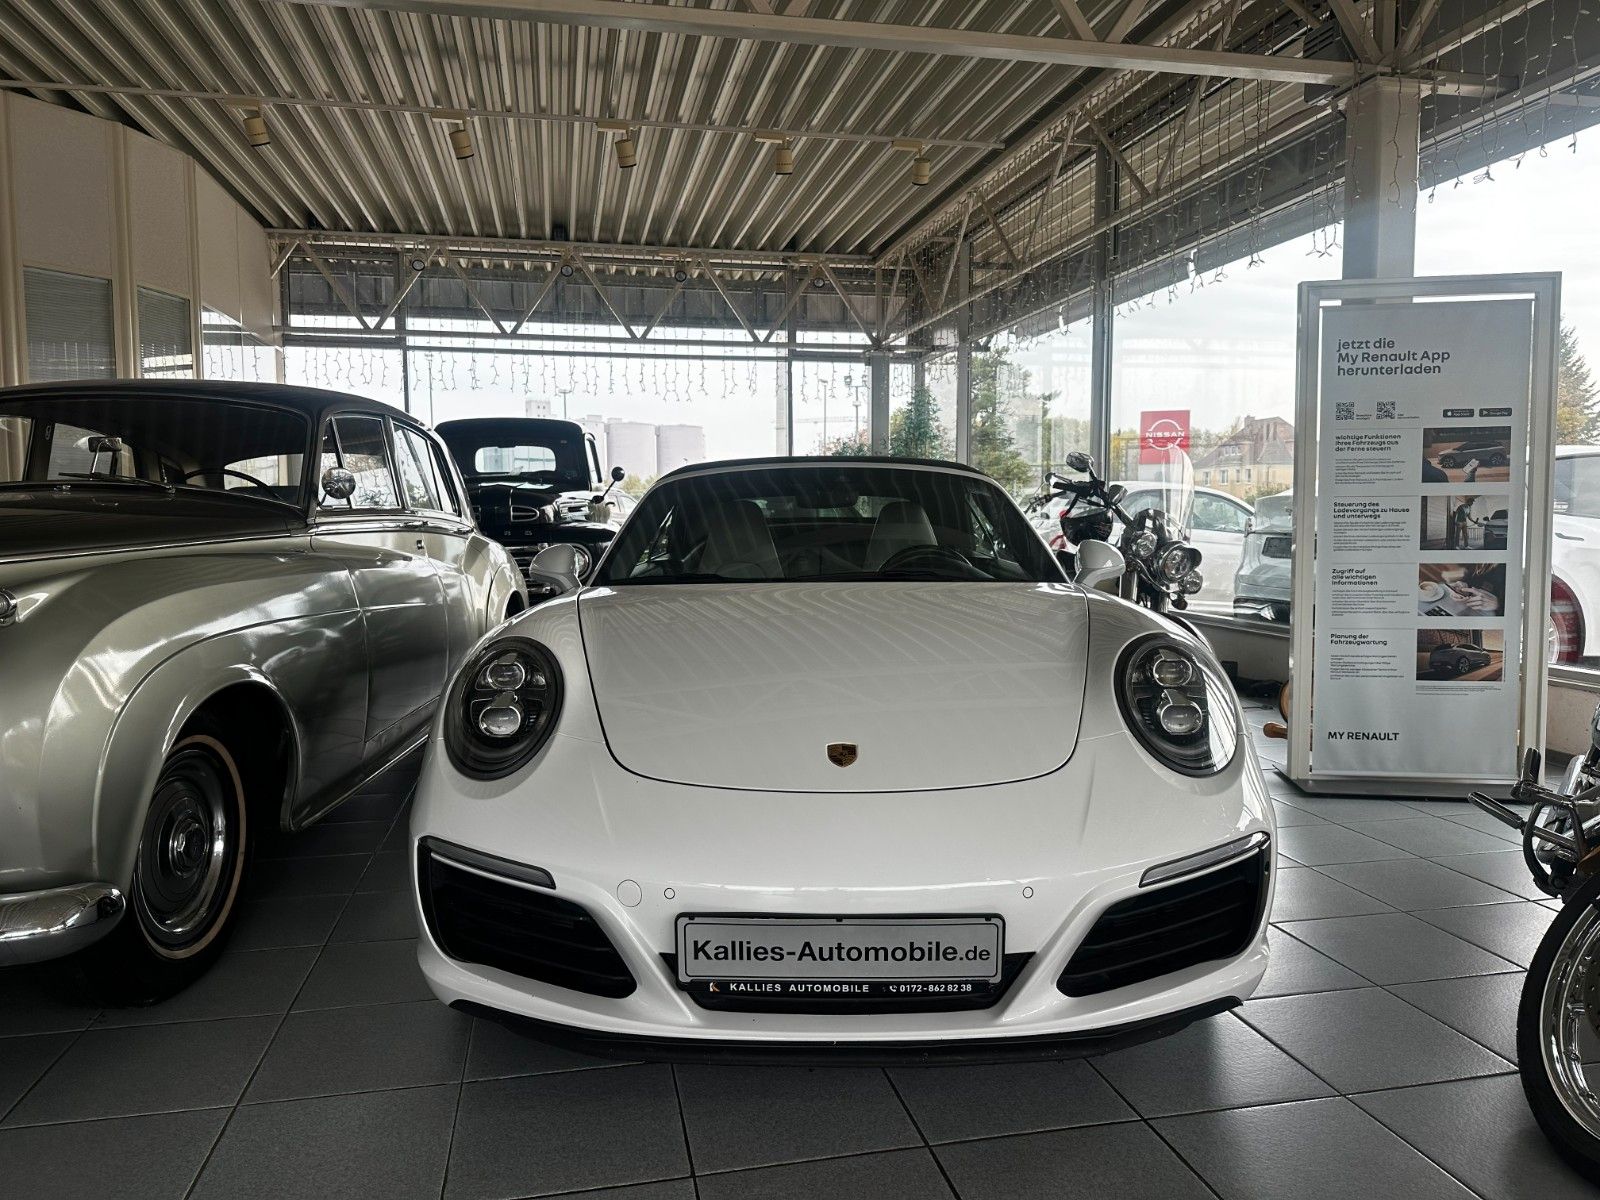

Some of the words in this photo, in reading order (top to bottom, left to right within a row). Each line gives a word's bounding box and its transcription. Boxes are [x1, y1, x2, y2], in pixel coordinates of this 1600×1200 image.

[1336, 339, 1371, 352] jetzt
[1373, 337, 1395, 349] die
[1337, 352, 1359, 365] My
[1361, 350, 1418, 362] Renault
[1420, 350, 1451, 363] App
[1337, 363, 1441, 376] herunterladen
[1327, 731, 1345, 740] MY
[1347, 731, 1400, 741] RENAULT
[692, 939, 991, 962] Kallies-Automobile.de
[730, 982, 782, 992] KALLIES
[788, 983, 870, 993] AUTOMOBILE
[899, 983, 946, 993] 0172-862
[946, 984, 959, 992] 82
[959, 984, 972, 992] 38
